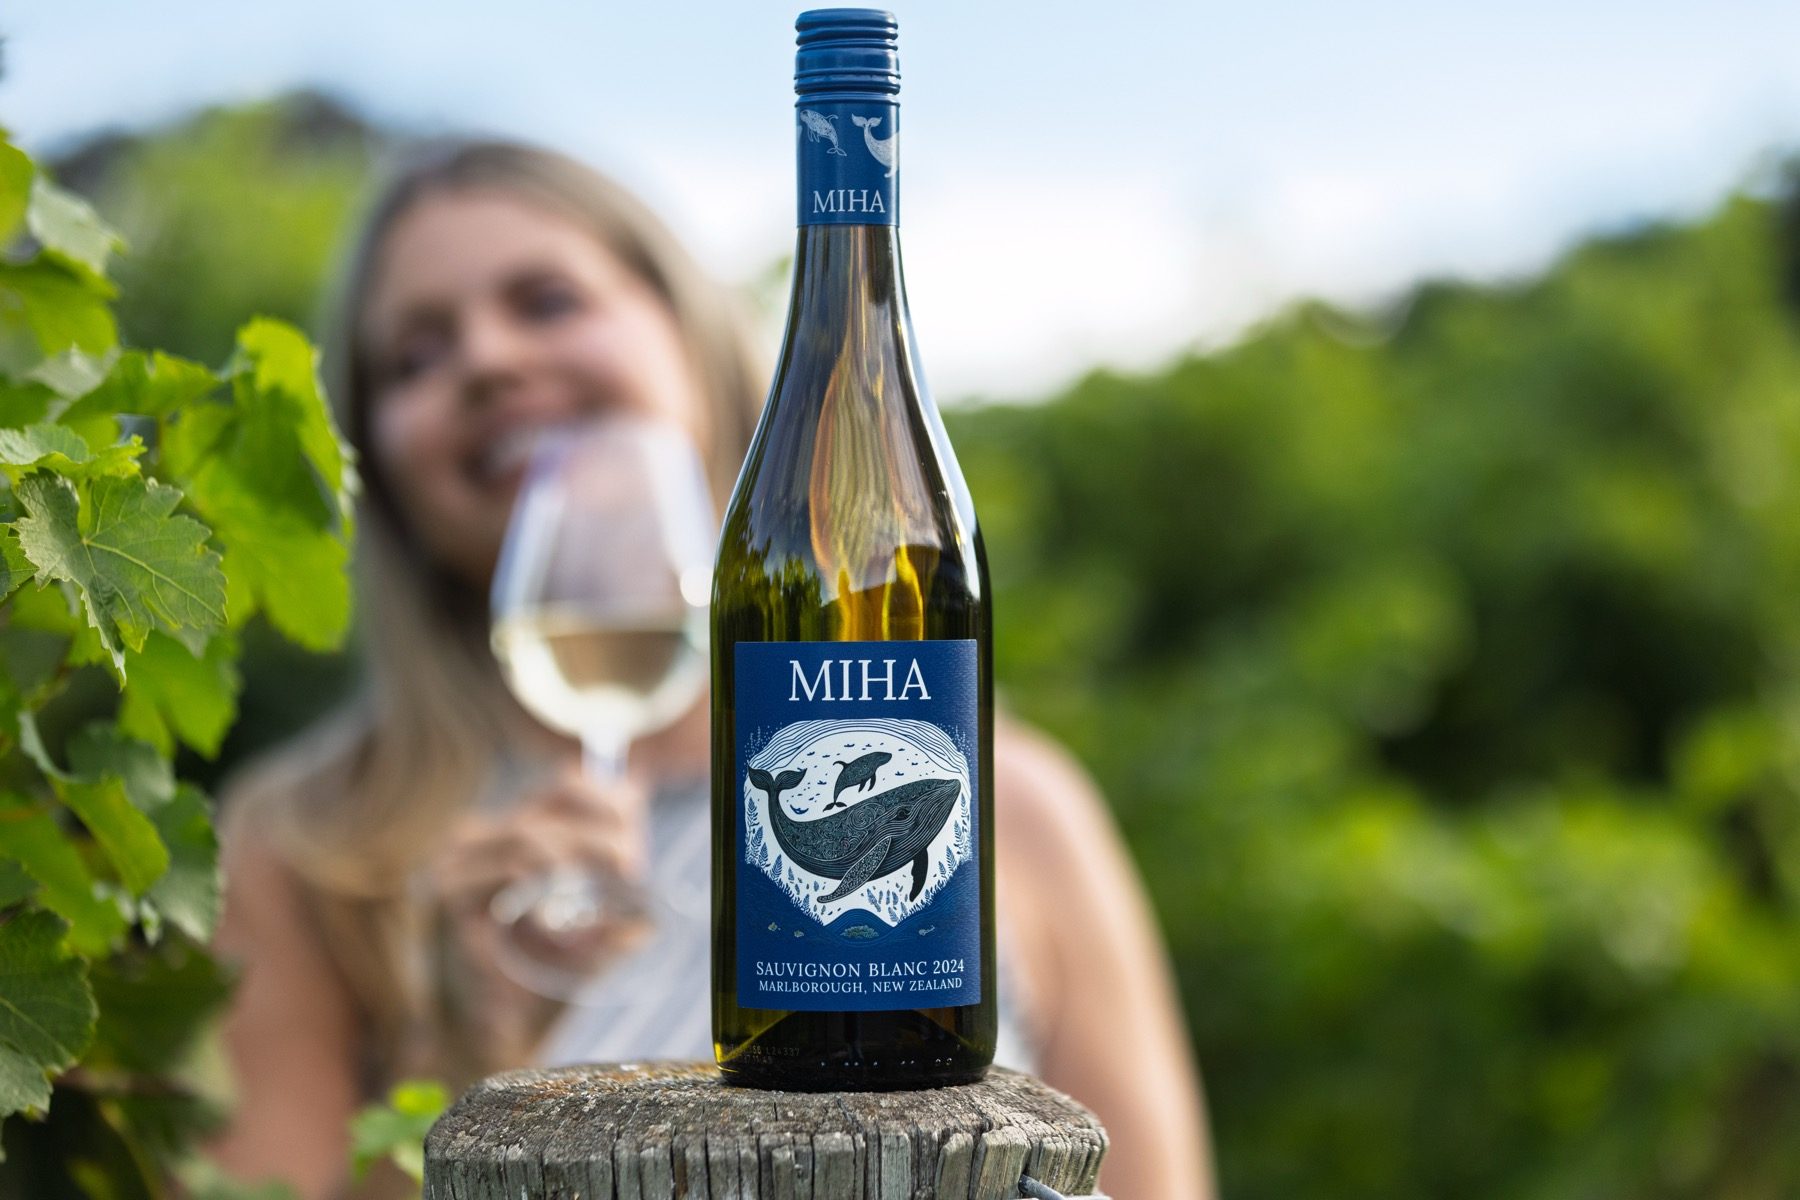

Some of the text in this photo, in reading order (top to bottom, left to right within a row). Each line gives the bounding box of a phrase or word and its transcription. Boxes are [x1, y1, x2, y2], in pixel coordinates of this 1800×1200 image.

[813, 189, 886, 213] MIHA
[788, 657, 932, 702] MIHA
[756, 958, 965, 978] SAUVIGNON BLANC 2024
[759, 977, 962, 994] MARLBOROUGH, NEW ZEALAND
